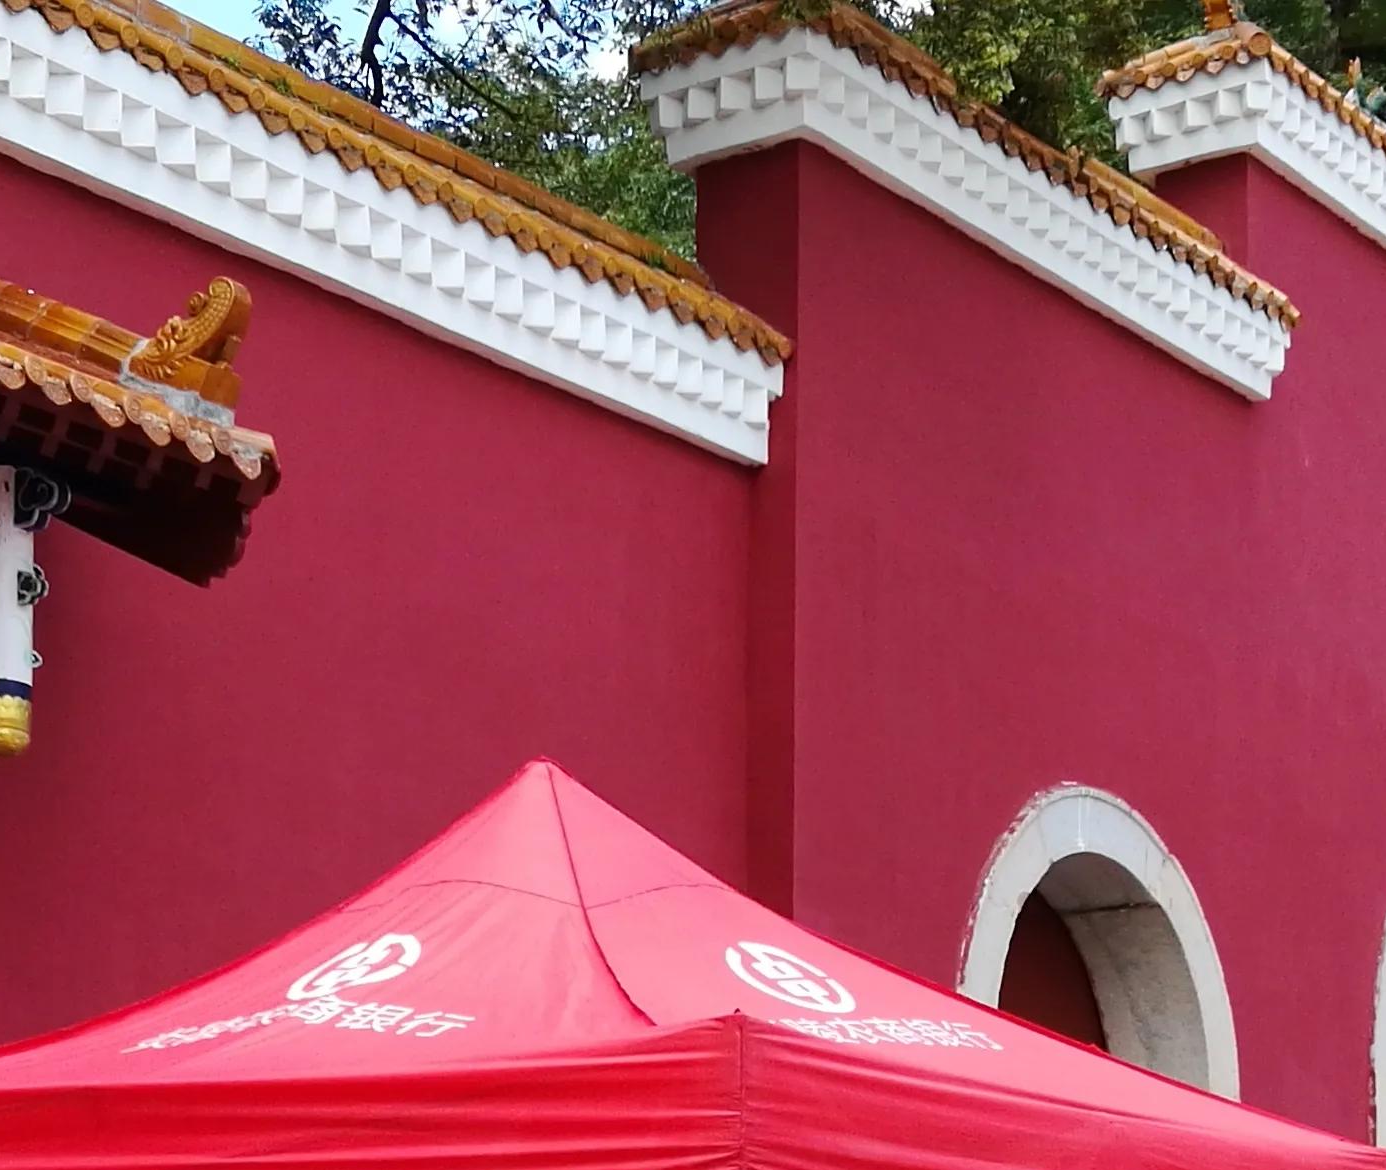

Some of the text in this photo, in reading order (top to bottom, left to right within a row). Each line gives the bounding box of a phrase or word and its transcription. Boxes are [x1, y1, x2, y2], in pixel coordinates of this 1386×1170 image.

[769, 1017, 1004, 1051] 陵农商银行
